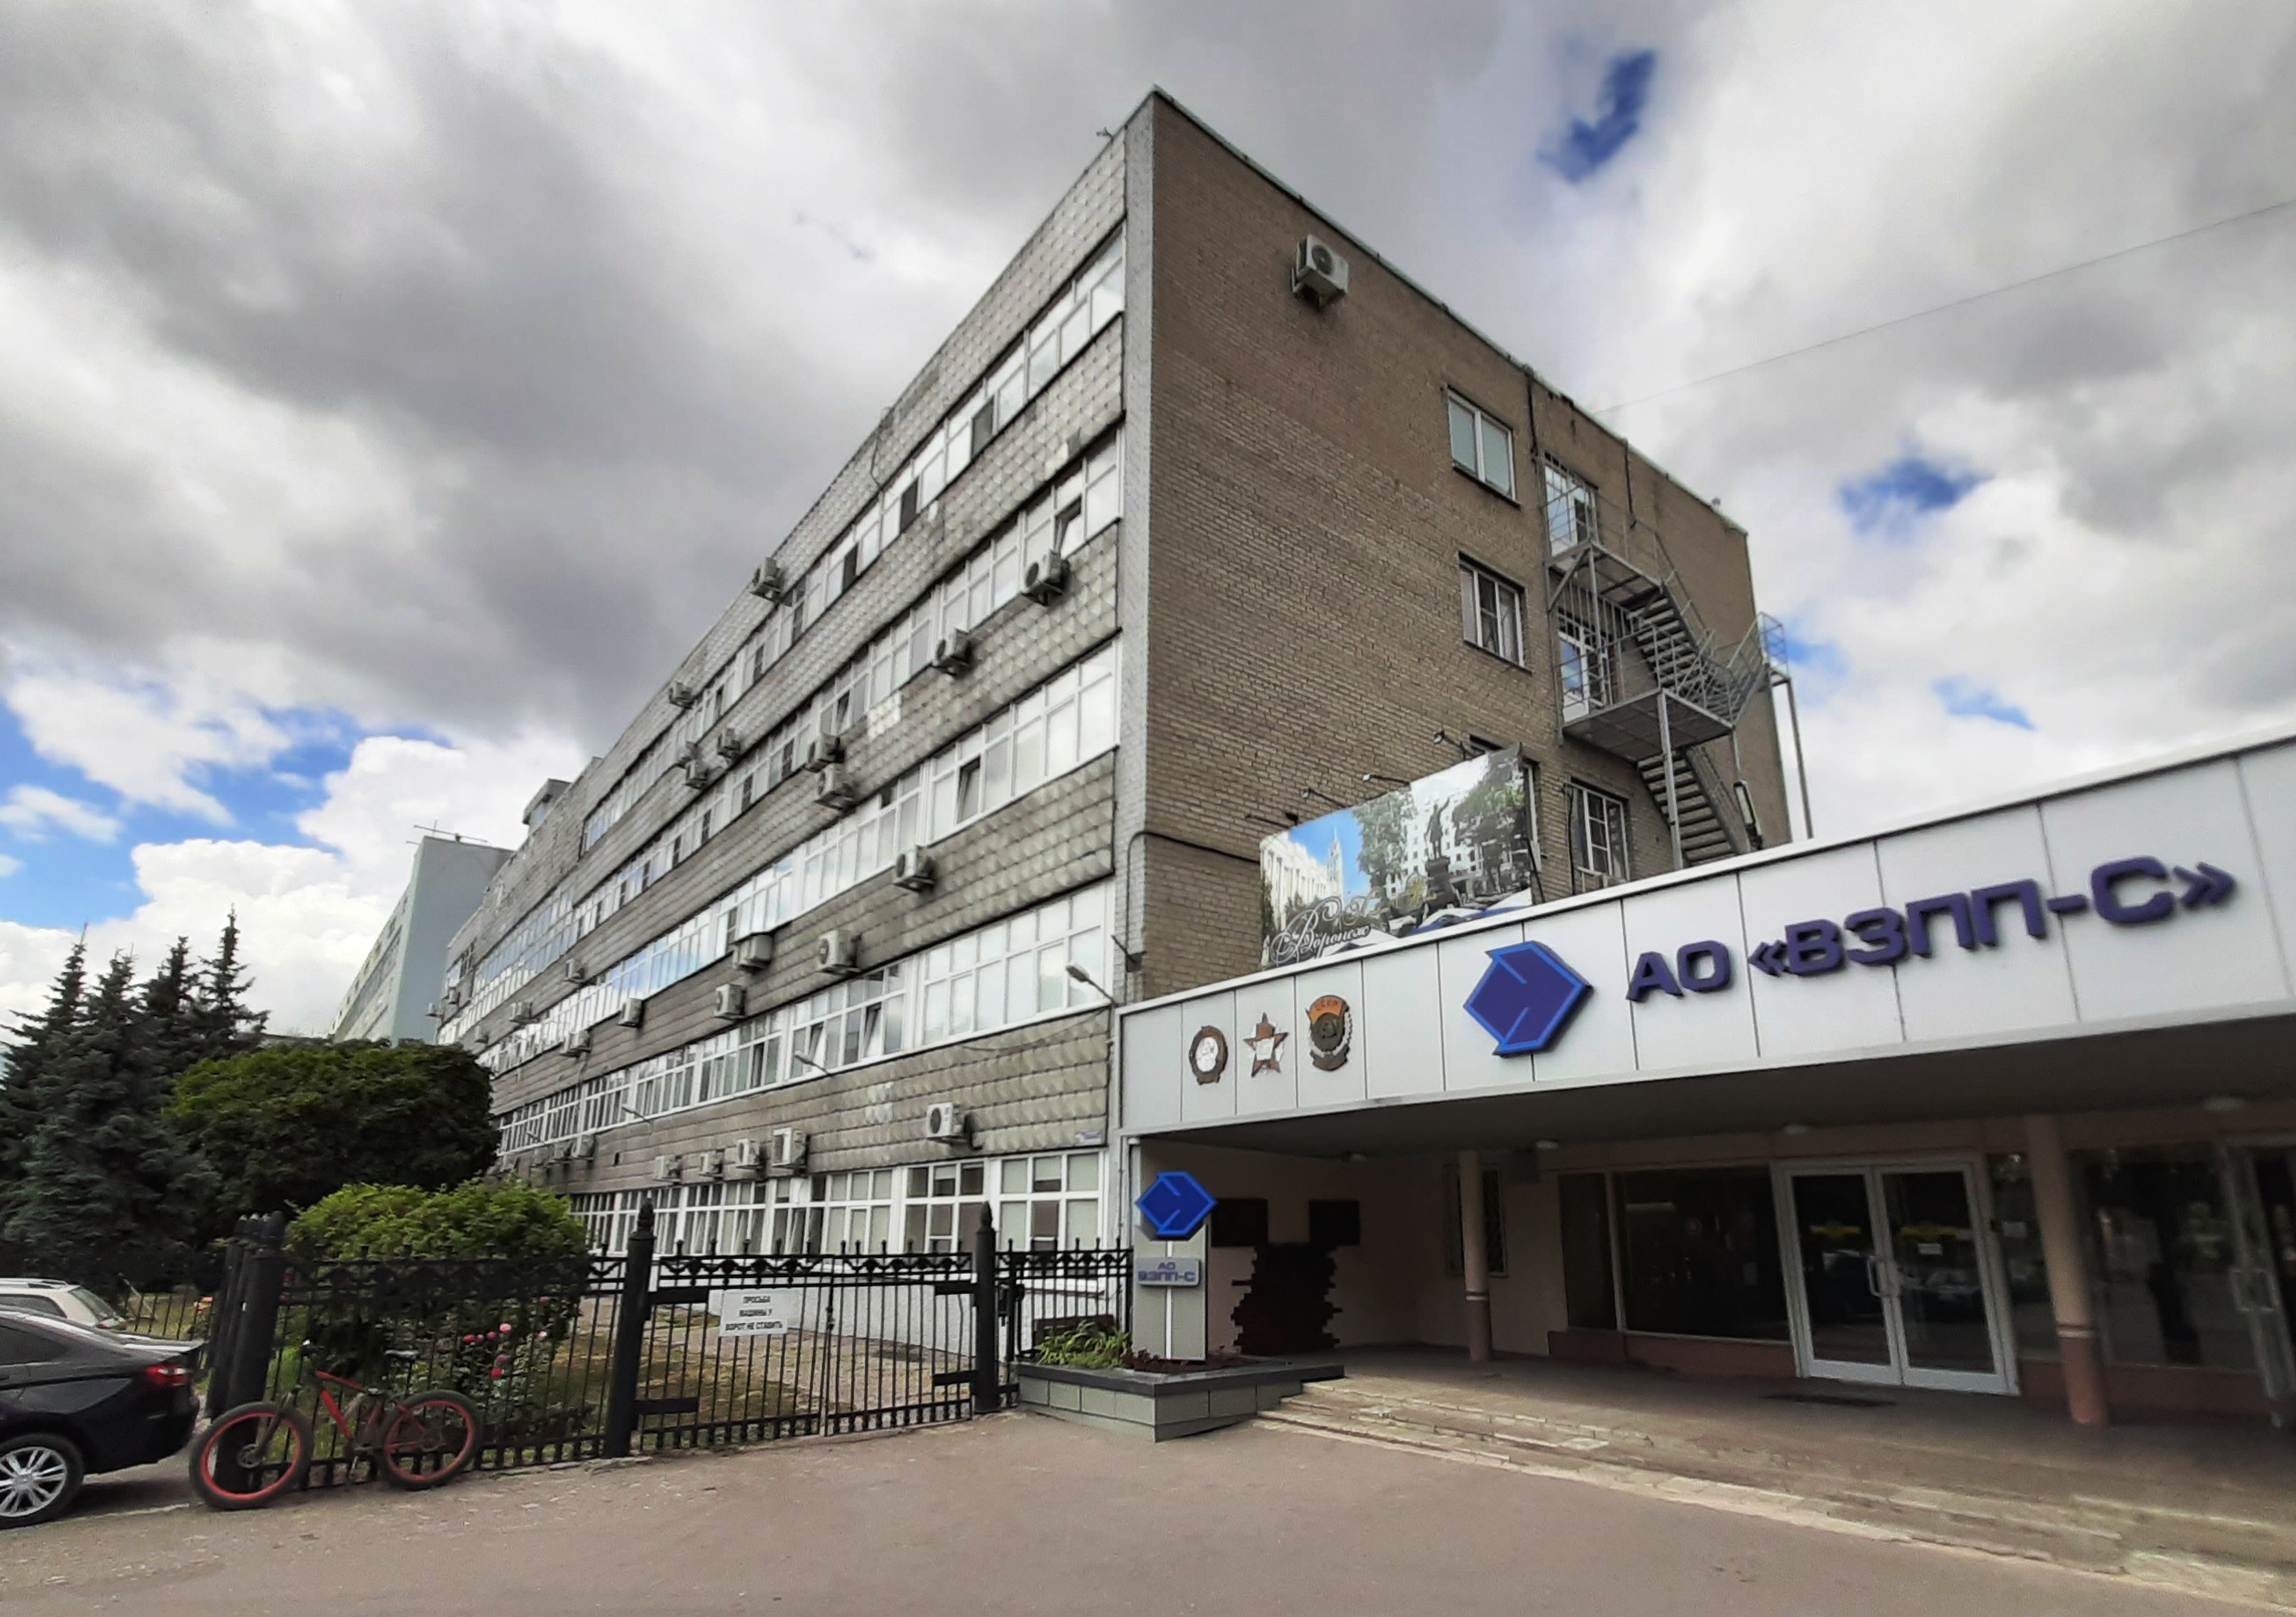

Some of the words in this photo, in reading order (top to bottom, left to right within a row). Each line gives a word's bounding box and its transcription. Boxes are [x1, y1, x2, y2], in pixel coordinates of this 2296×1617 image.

[1626, 938, 1733, 1002] АО
[1748, 855, 2237, 978] «ВЗПП-С»
[1157, 1262, 1176, 1271] АО
